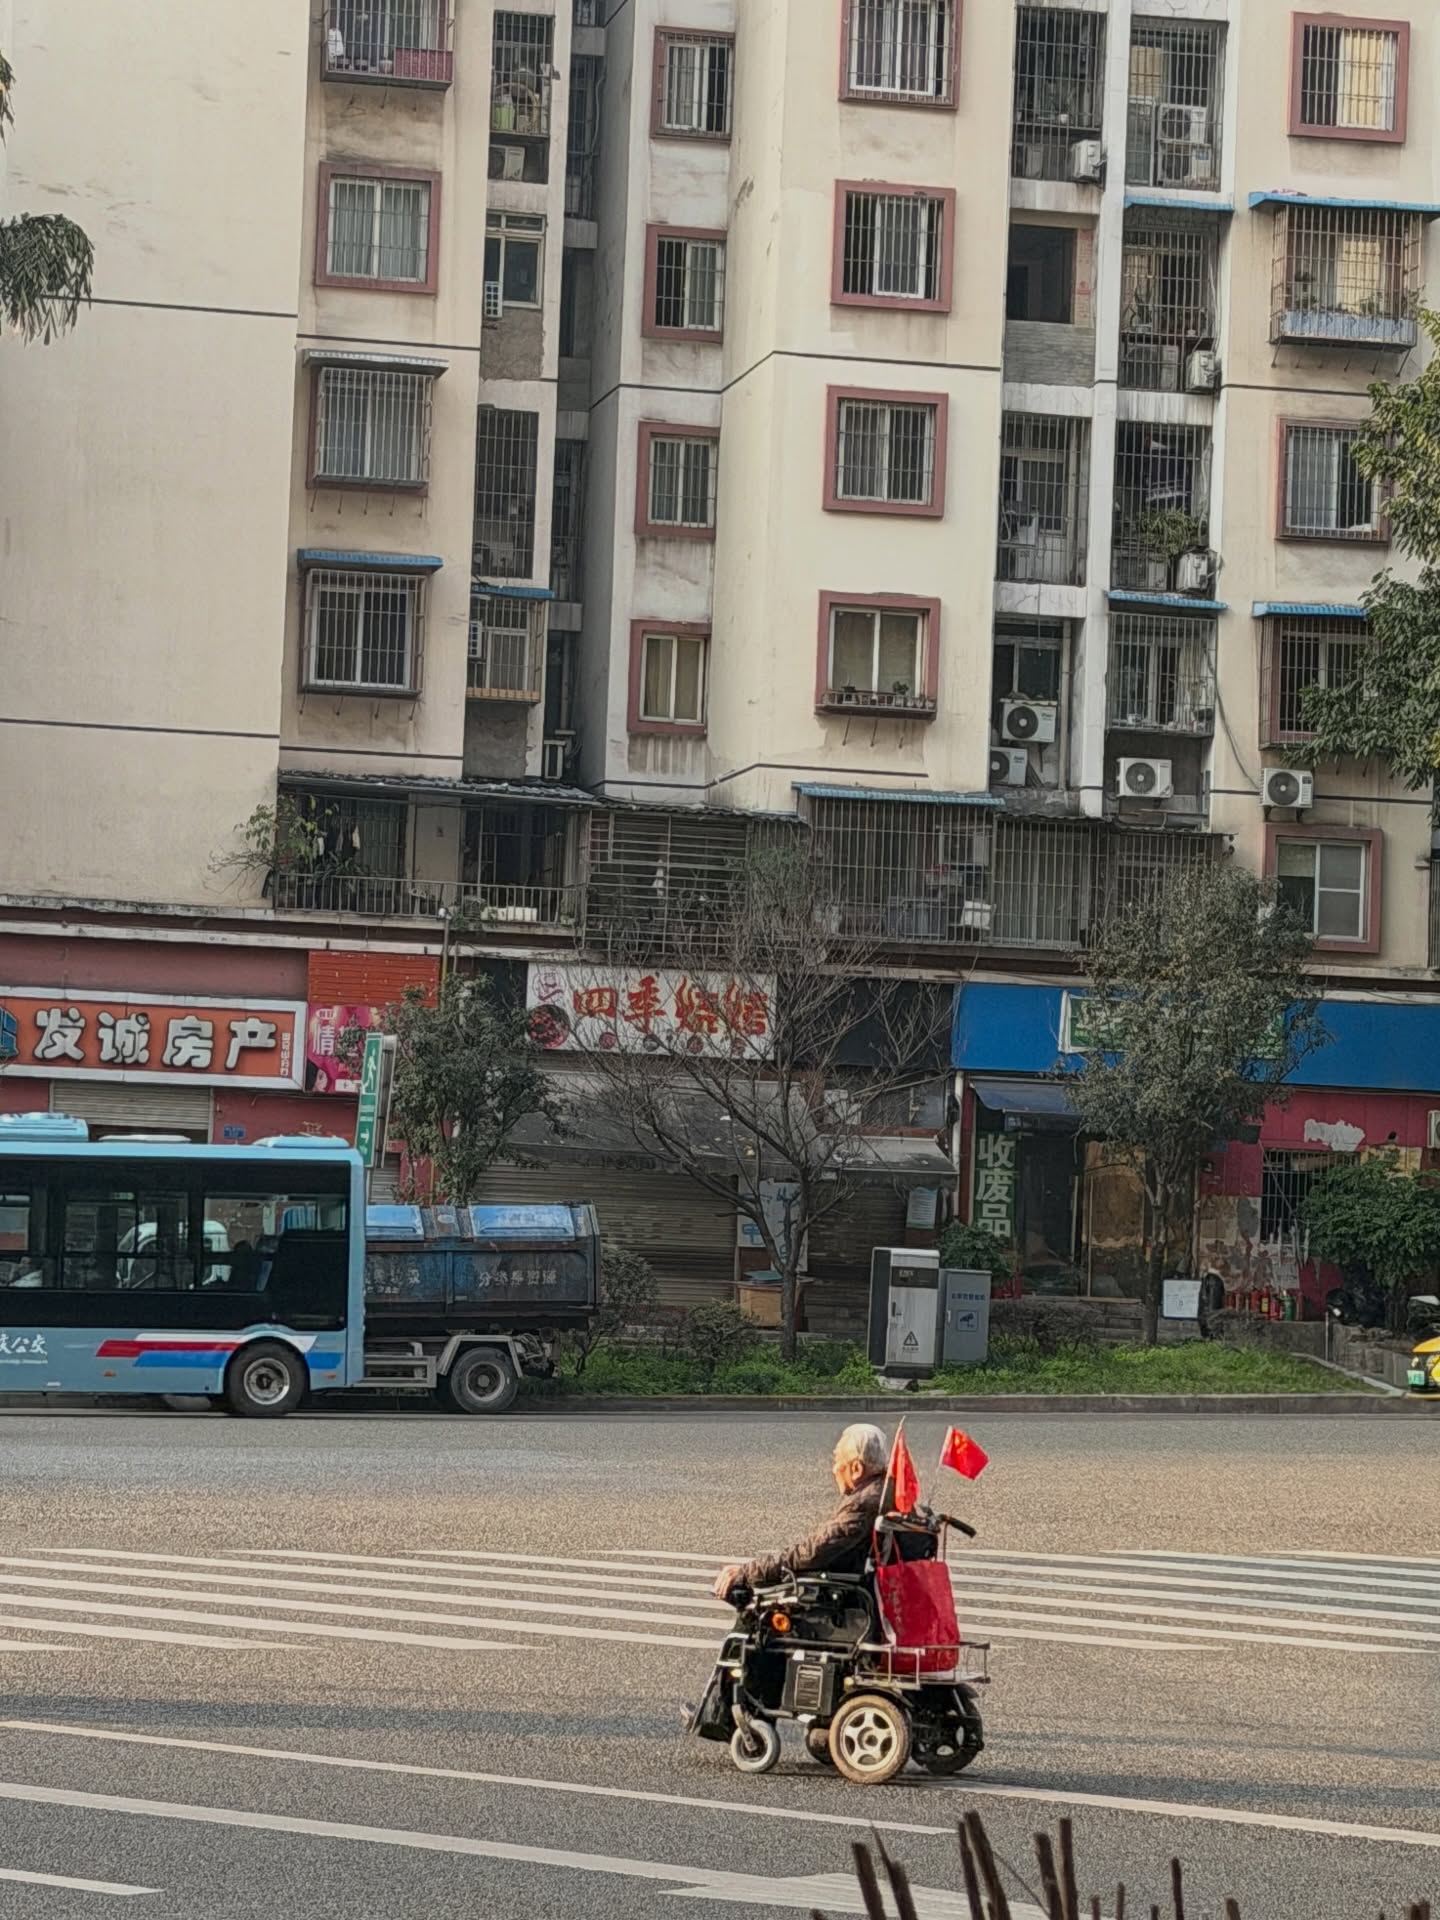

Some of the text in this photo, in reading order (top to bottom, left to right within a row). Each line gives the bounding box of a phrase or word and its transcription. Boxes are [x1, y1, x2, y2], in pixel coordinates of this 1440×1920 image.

[573, 975, 769, 1036] 四季烧烤
[34, 1006, 277, 1070] 发诚房产
[976, 1133, 1017, 1238] 收废品
